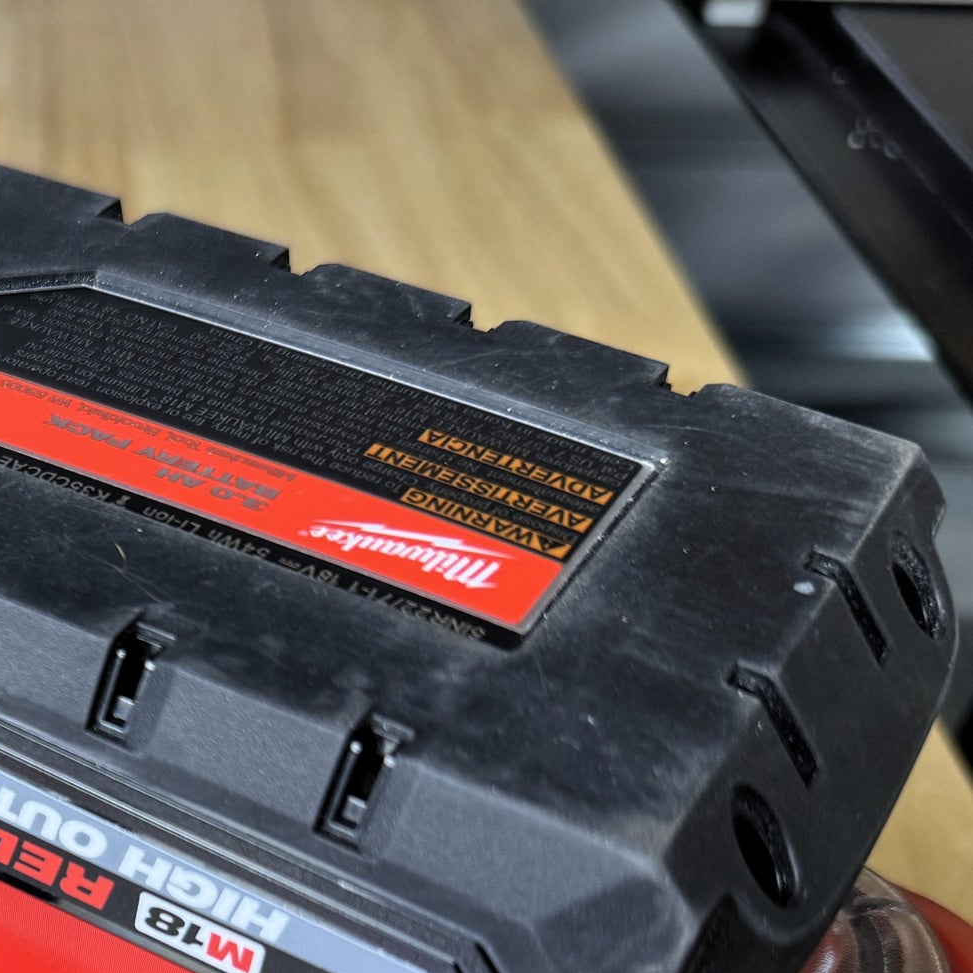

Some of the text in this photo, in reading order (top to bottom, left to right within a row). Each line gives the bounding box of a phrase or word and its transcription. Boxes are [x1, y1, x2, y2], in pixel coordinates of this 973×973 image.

[39, 412, 282, 501] BATTERY PACK
[193, 405, 291, 443] MILWAUKEE
[151, 465, 271, 513] 3.0 AH
[366, 444, 587, 529] AVERTISSEMENT
[421, 430, 609, 501] ADVERTENCIA
[403, 489, 538, 543] WARNING
[305, 523, 498, 590] Milwaukee
[117, 843, 290, 942] HIGH
